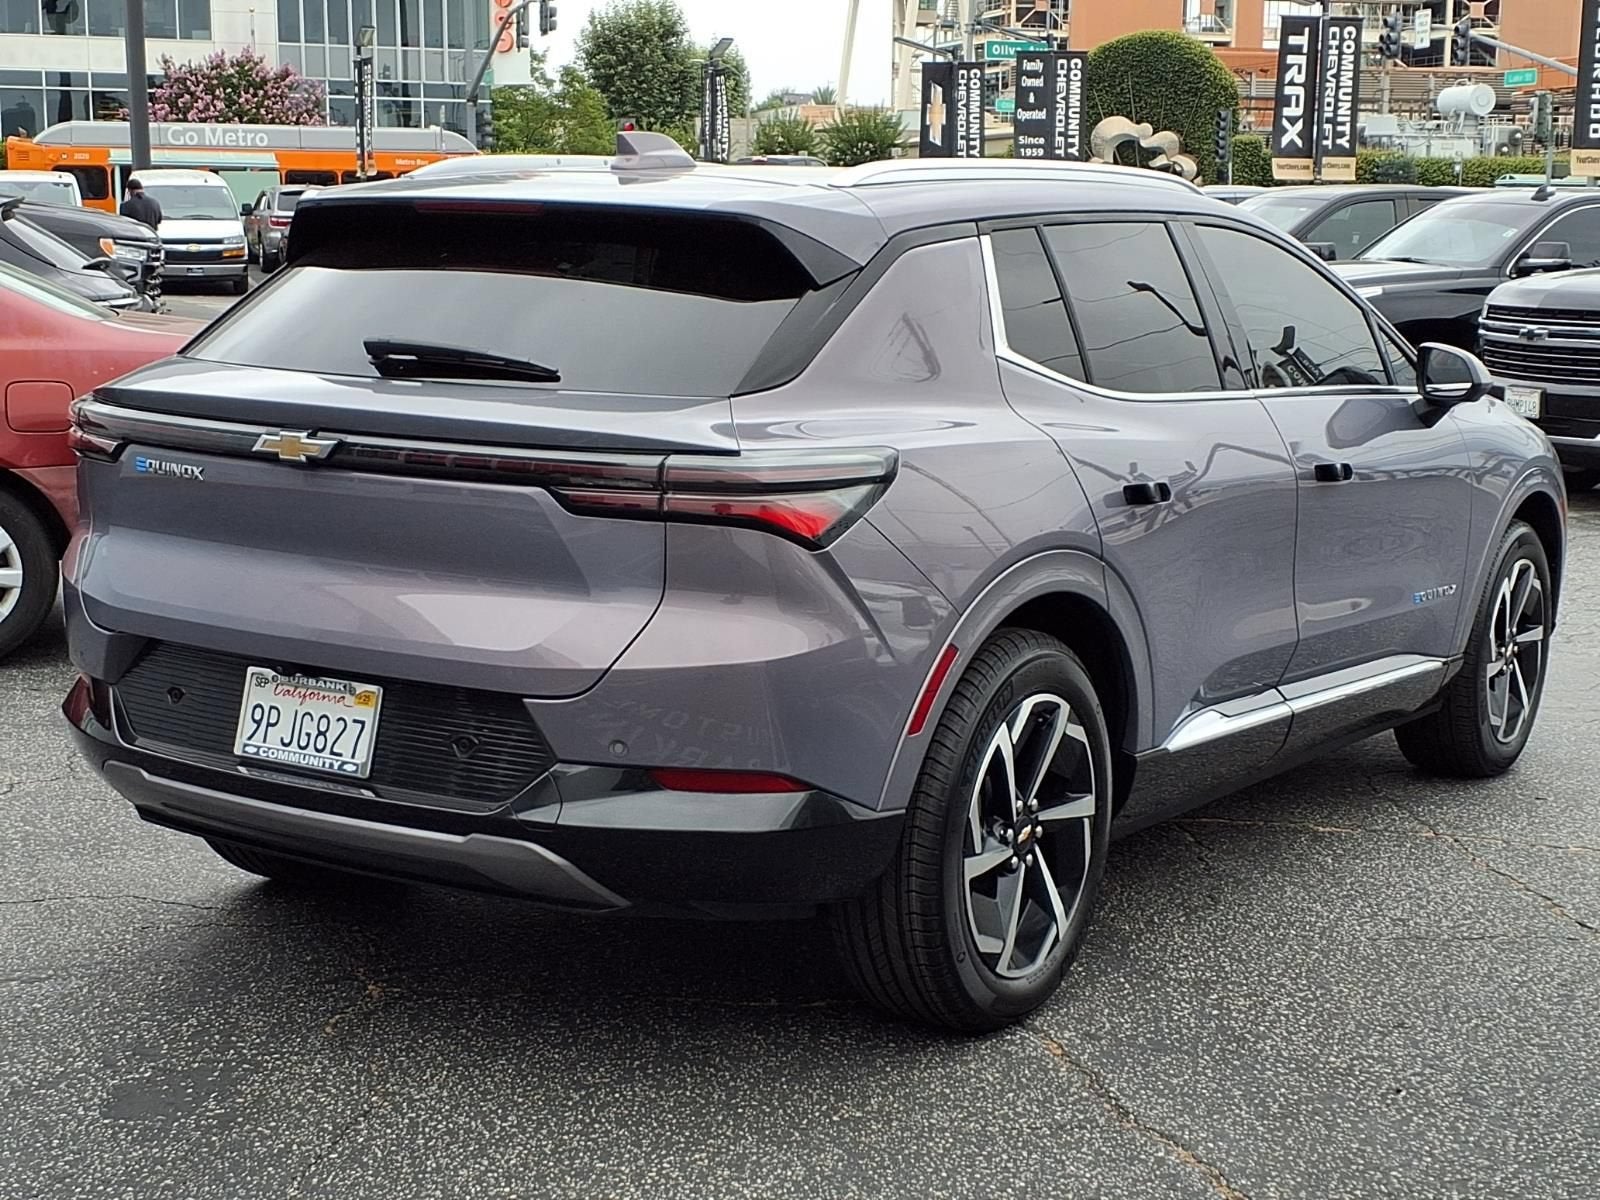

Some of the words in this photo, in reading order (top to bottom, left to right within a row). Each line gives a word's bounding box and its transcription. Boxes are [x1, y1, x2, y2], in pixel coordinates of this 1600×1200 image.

[1023, 59, 1043, 72] Family
[1021, 75, 1044, 87] Owned
[1281, 27, 1309, 148] TRAX
[1335, 25, 1357, 149] COMMUNITY
[1028, 91, 1035, 103] &
[1055, 58, 1067, 157] CHEVROLET
[1067, 58, 1082, 156] COMMUNITY
[721, 74, 729, 160] COMMUNITY
[957, 69, 967, 157] CHEVROLET
[969, 68, 981, 157] COMMUNITY
[1017, 108, 1047, 122] Operated
[167, 126, 198, 145] Go
[205, 127, 269, 146] Metro
[1018, 135, 1045, 145] Since
[1020, 148, 1044, 156] 1959
[136, 456, 204, 481] EQUINOX
[281, 674, 345, 691] BURBANK
[274, 683, 350, 707] California
[247, 703, 366, 760] 9PJG827
[259, 747, 343, 770] COMMUNITY
